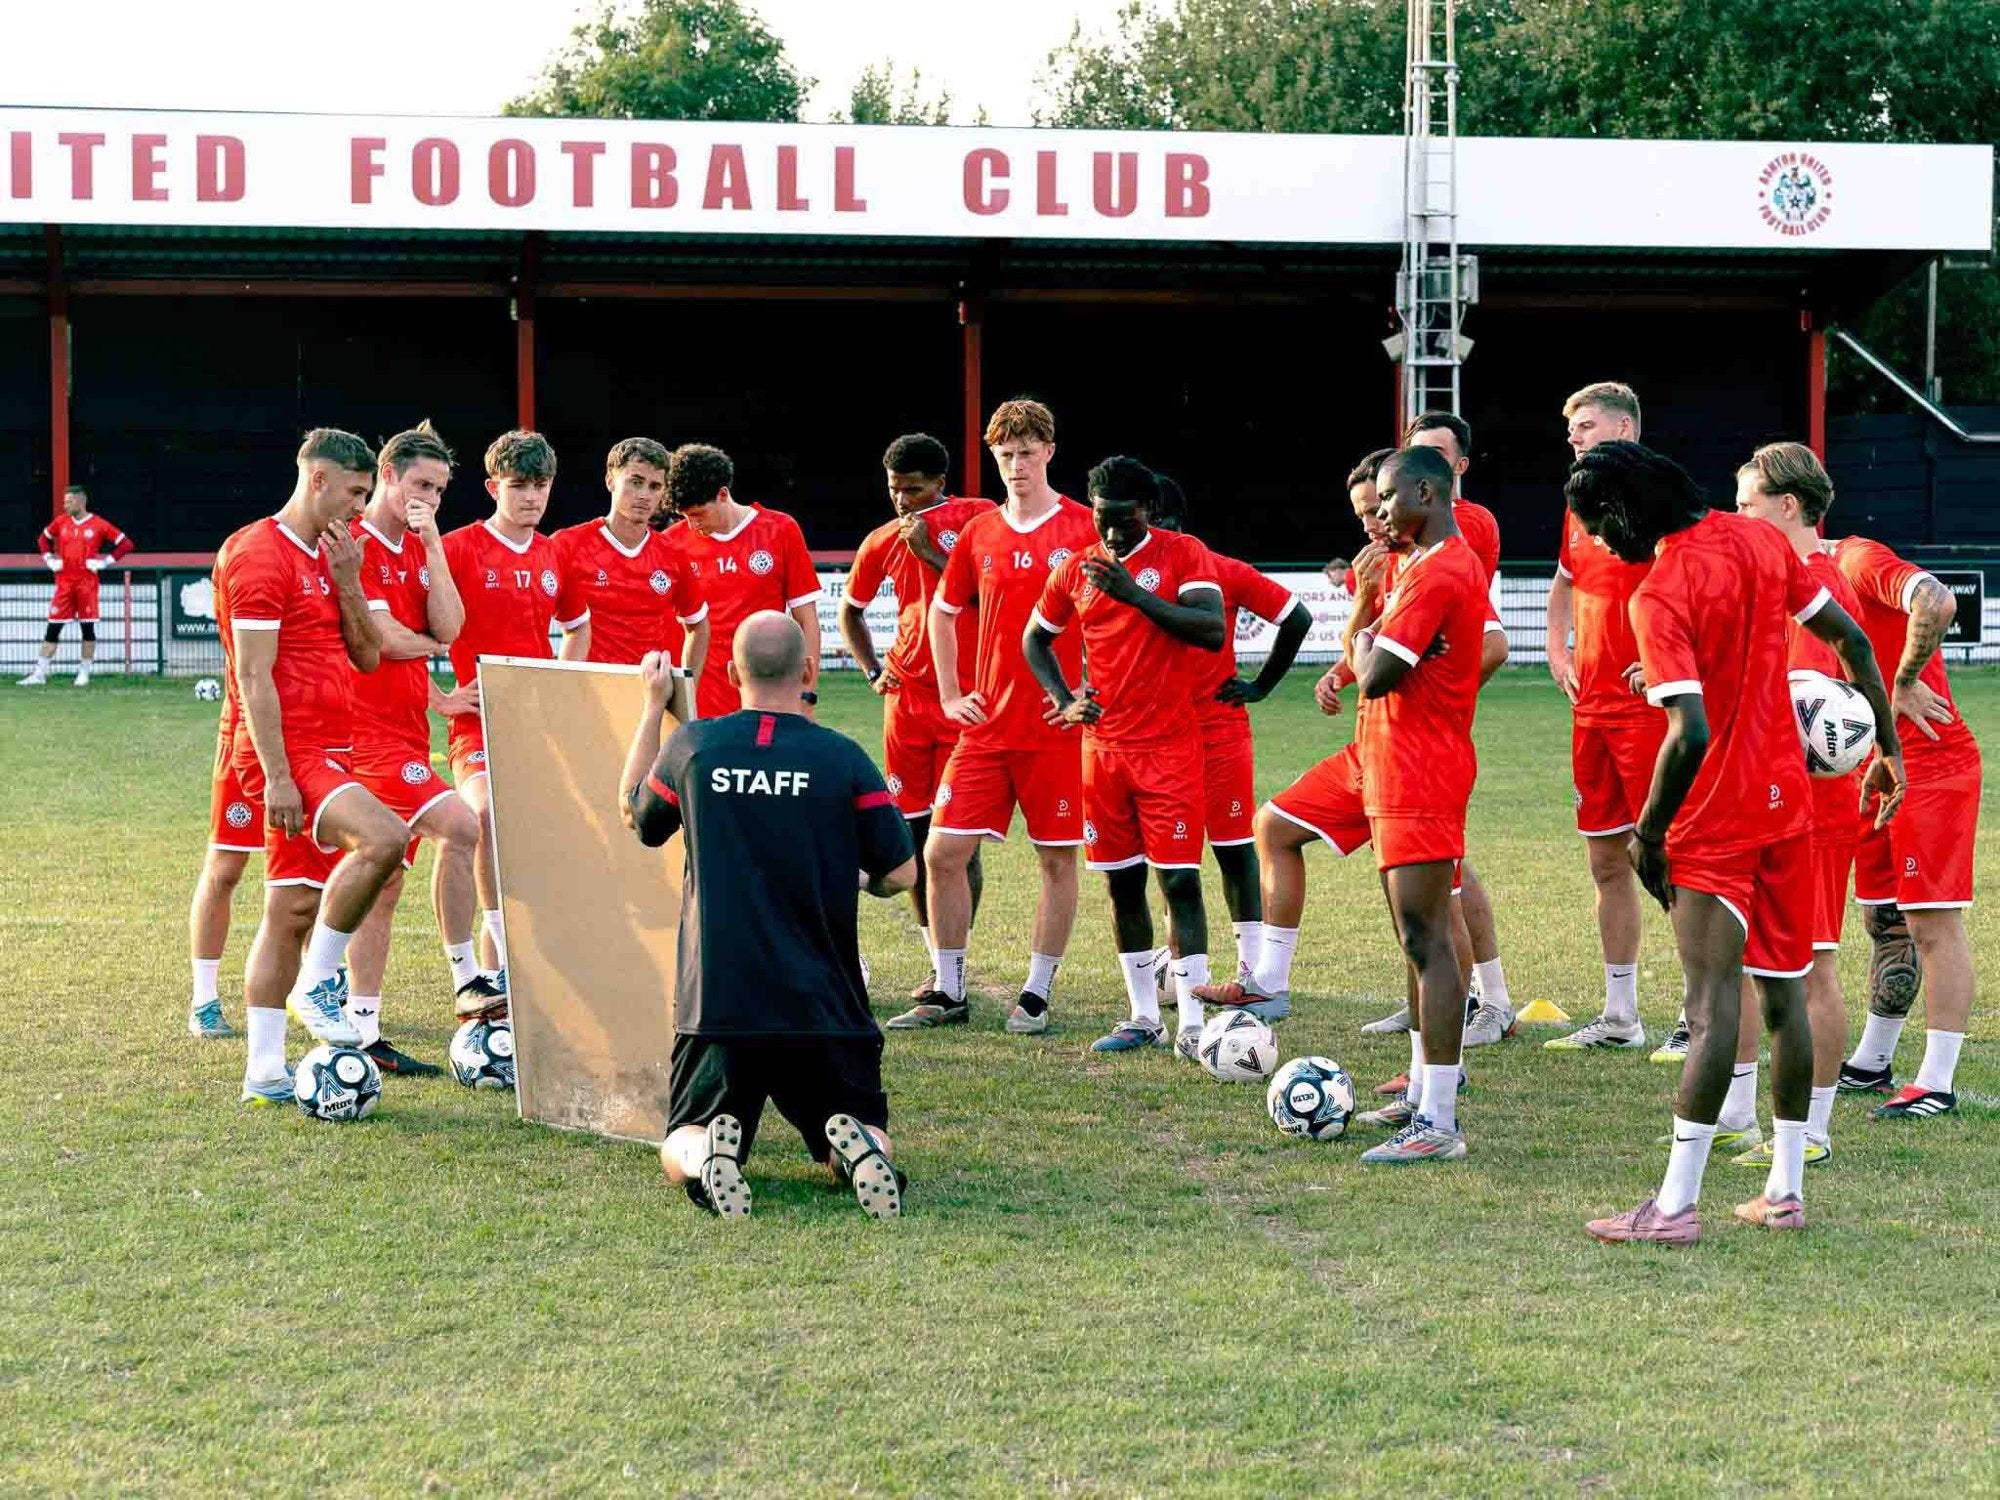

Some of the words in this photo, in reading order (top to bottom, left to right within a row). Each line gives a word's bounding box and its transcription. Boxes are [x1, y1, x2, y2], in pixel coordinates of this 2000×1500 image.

[11, 132, 246, 203] ITED
[350, 137, 868, 213] FOOTBALL
[963, 147, 1211, 218] CLUB
[1758, 151, 1797, 185] ASHTON
[1800, 152, 1832, 185] UNITED
[1758, 205, 1806, 236] FOOTBALL
[1807, 206, 1831, 232] CLUB
[716, 556, 738, 574] 14
[1012, 551, 1032, 569] 16
[397, 570, 407, 585] 7
[514, 570, 531, 588] 17
[1824, 719, 1838, 758] Mitre
[711, 767, 810, 796] STAFF
[323, 1098, 353, 1114] Mitre
[1292, 1093, 1315, 1103] DELTA
